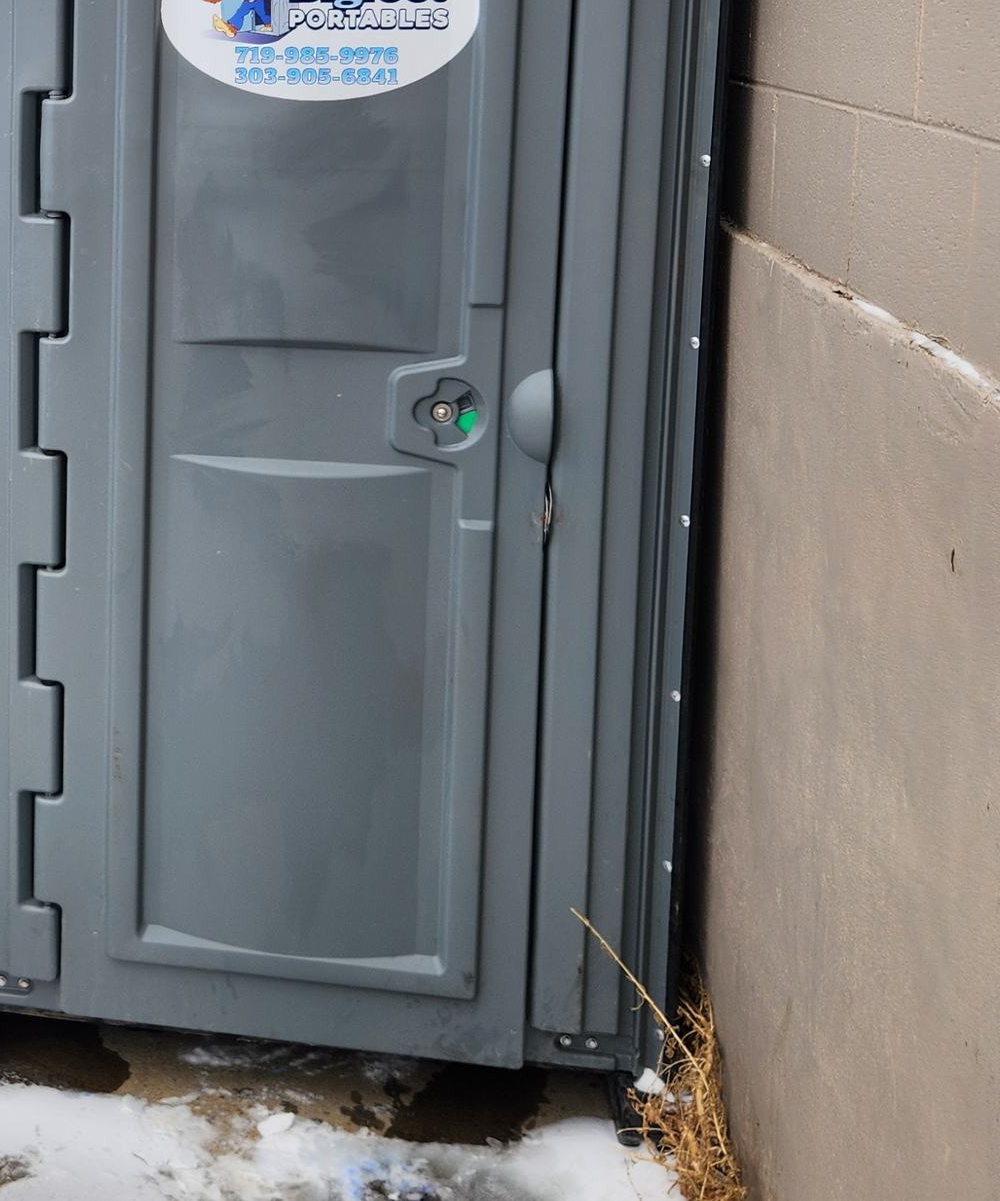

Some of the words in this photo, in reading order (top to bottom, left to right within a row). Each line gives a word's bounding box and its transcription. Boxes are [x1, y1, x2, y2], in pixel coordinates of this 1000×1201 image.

[288, 8, 450, 30] PORTABLES
[234, 46, 399, 65] 719-985-9976
[234, 67, 399, 86] 303-905-6841
